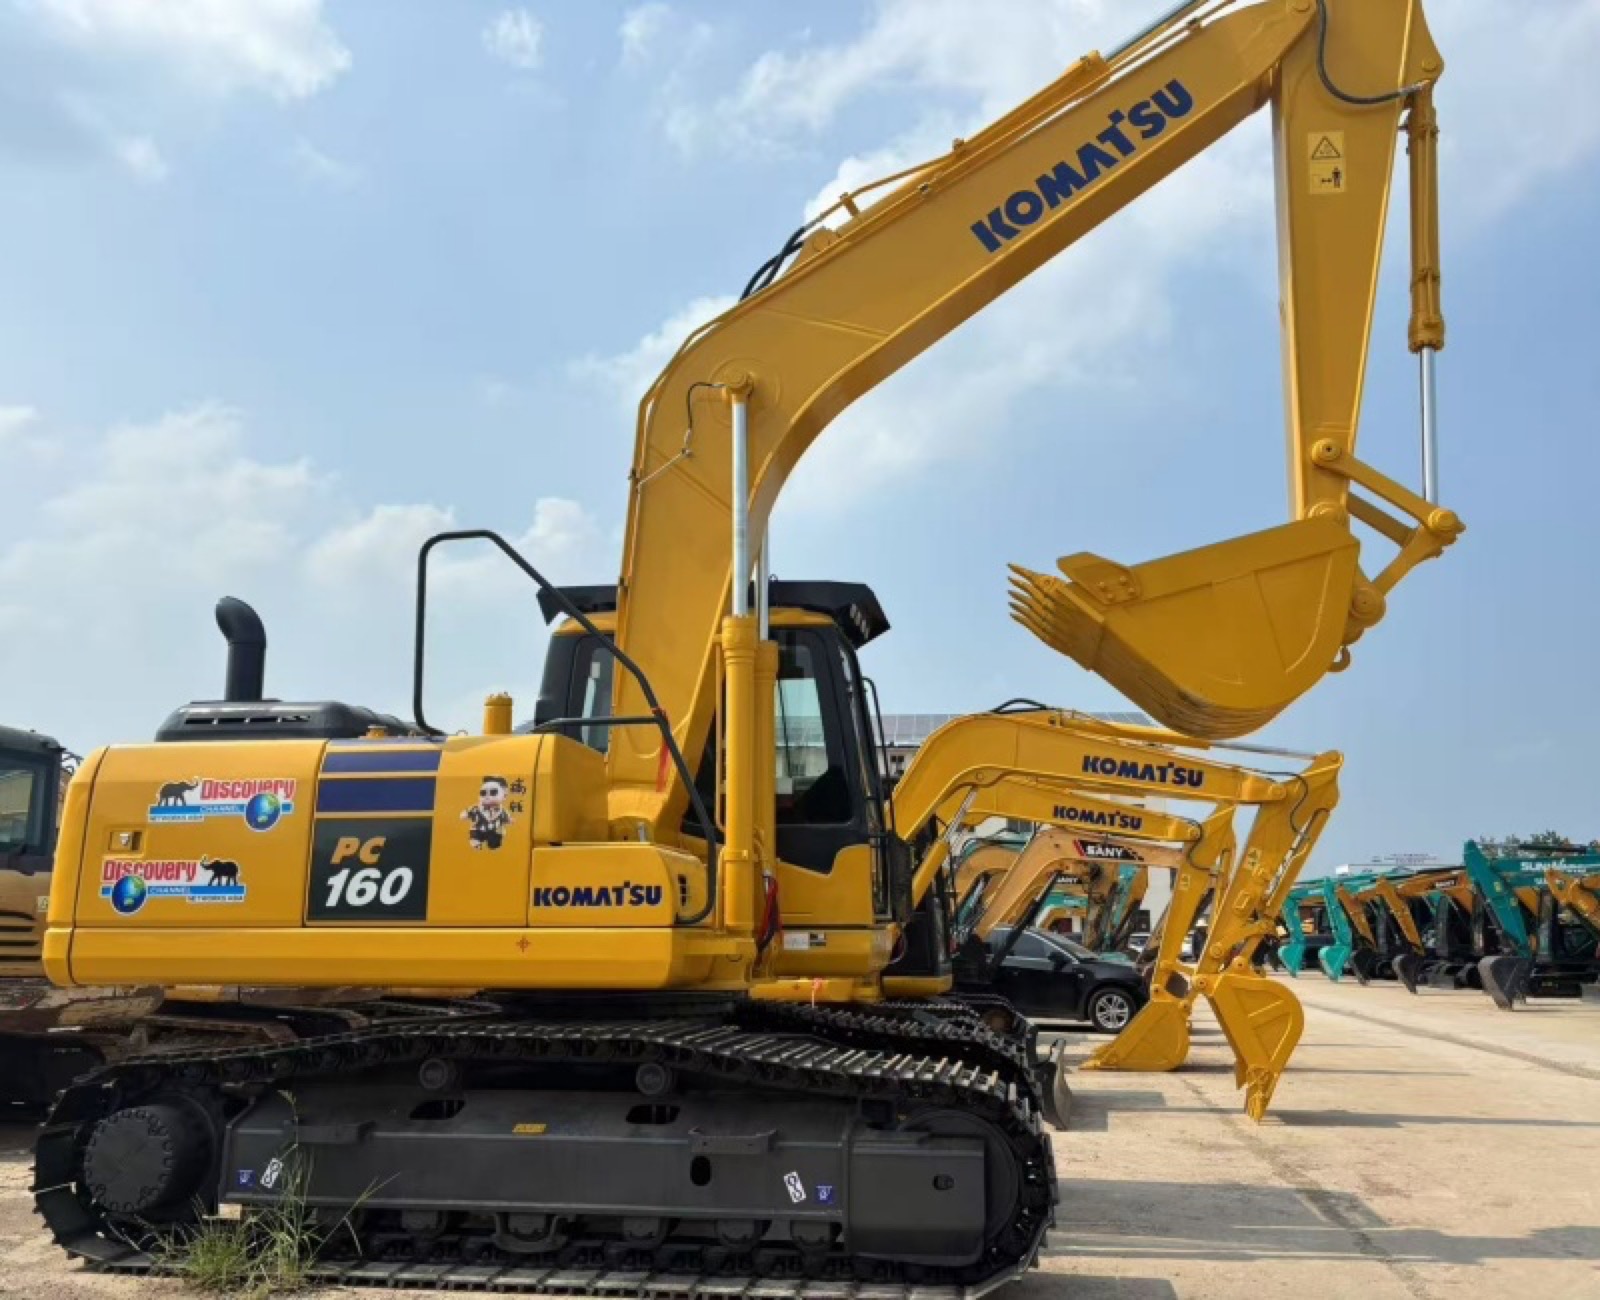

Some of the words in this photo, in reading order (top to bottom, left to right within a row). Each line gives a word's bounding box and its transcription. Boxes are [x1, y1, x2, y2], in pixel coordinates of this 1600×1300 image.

[970, 78, 1194, 253] KOMATSU
[1082, 755, 1204, 787] KOMATSU
[1053, 805, 1142, 830] KOMATSU
[330, 836, 387, 865] PC
[1086, 845, 1123, 857] SANY
[326, 867, 414, 907] 160
[533, 880, 662, 907] KOMATSU
